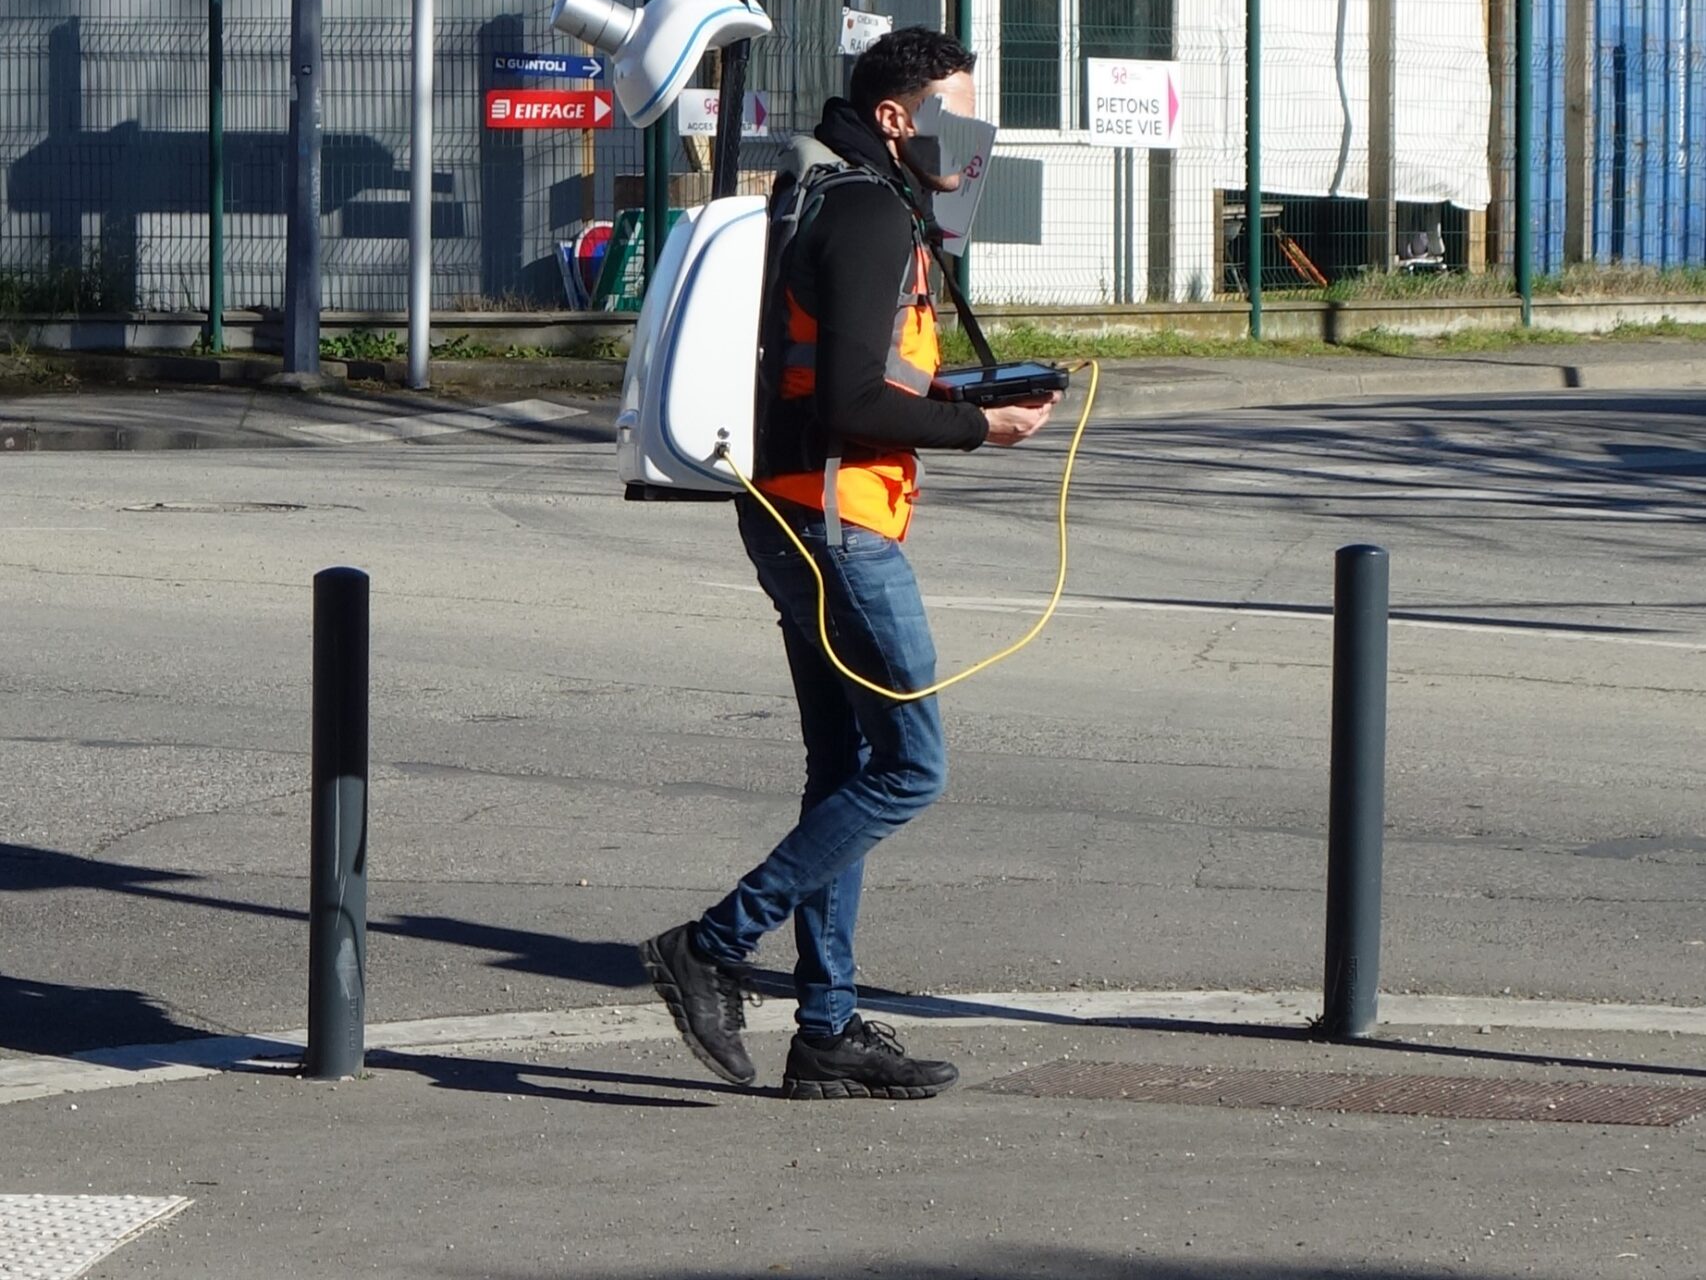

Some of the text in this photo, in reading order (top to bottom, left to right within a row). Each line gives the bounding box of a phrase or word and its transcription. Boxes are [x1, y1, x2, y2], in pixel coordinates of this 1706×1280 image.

[507, 58, 567, 73] GUINTOLI
[514, 103, 586, 120] EIFFAGE
[1096, 97, 1160, 115] PIETONS
[687, 122, 713, 132] ACCES
[1096, 118, 1163, 136] BASE VIE
